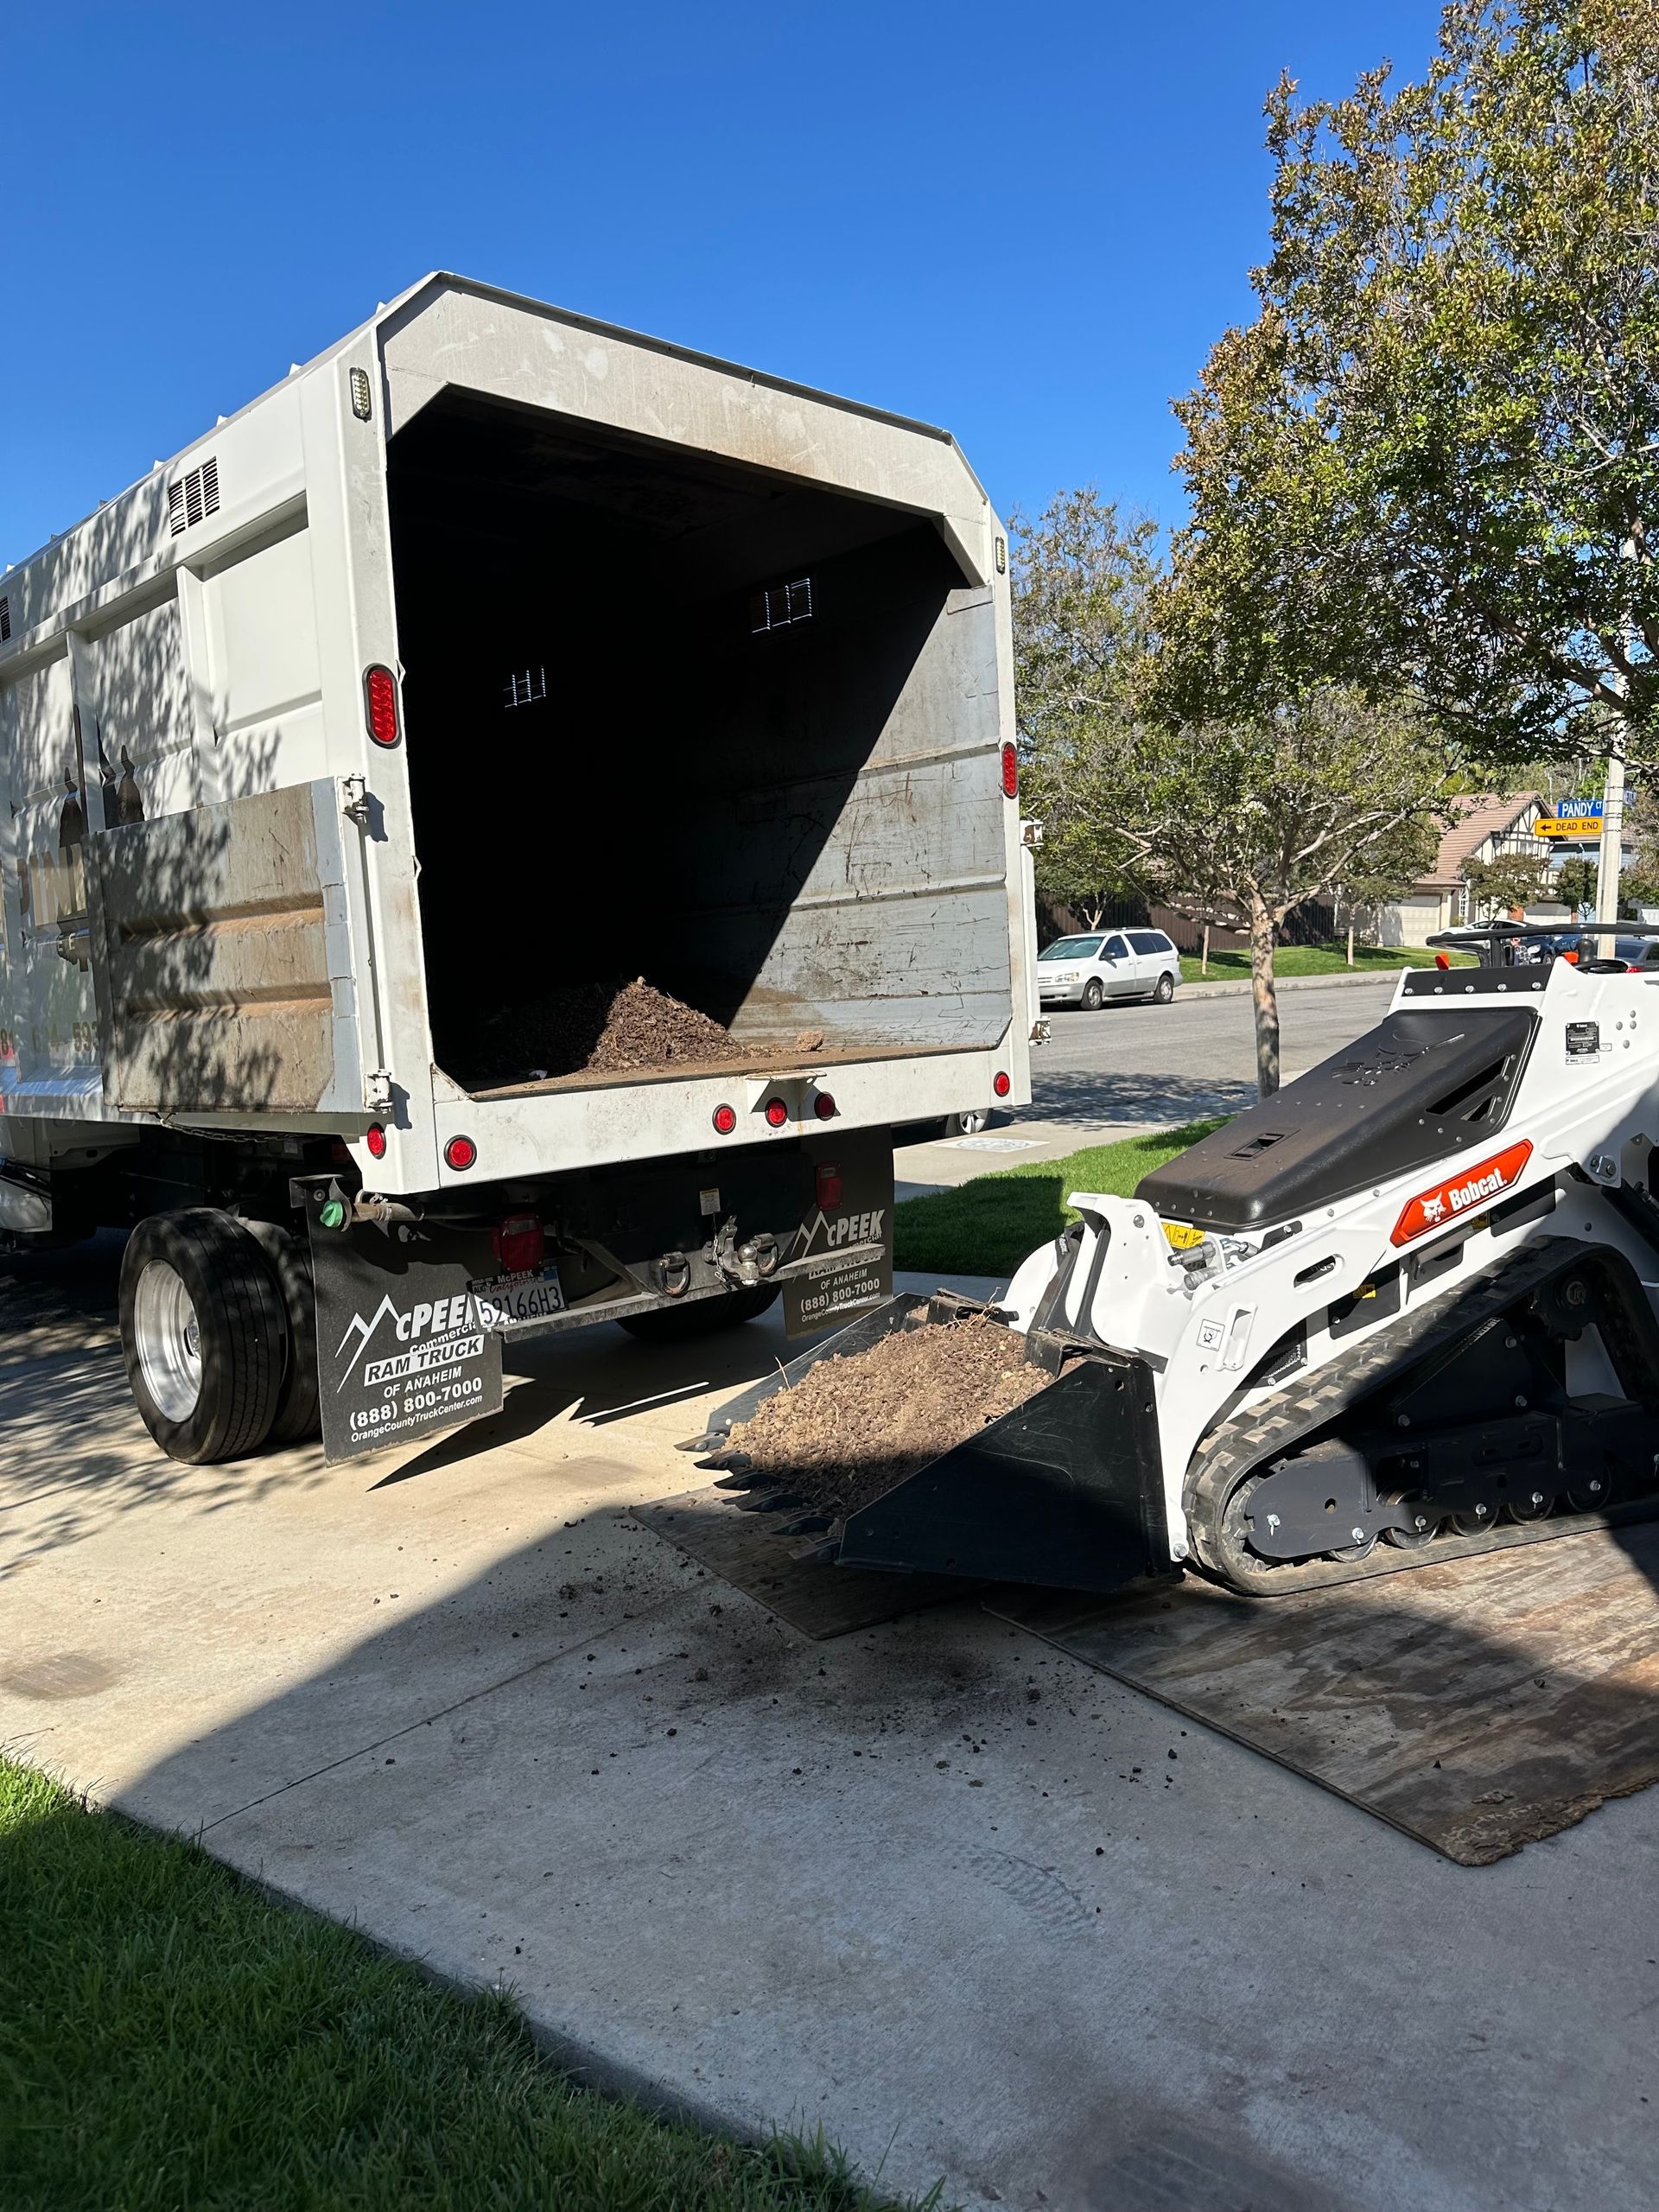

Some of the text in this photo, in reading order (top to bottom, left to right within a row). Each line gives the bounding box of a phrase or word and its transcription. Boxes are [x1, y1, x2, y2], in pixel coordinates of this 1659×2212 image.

[1555, 822, 1599, 831] DEAD END
[1561, 801, 1603, 817] PANDY CT
[1447, 1167, 1504, 1211] Bobcat
[474, 1285, 486, 1294] AUG
[497, 1269, 534, 1284] McPEEK
[820, 1268, 868, 1290] OF ANAHEIM
[480, 1287, 562, 1325] 59166H3
[800, 1278, 880, 1313] (888) 800-7000
[410, 1319, 477, 1356] Commerci
[368, 1338, 481, 1382] RAM TRUCK
[384, 1366, 462, 1399] OF ANAHEIM
[349, 1376, 482, 1431] (888) 800-7000
[351, 1395, 483, 1443] OrangeCountyTruckCenter.com
